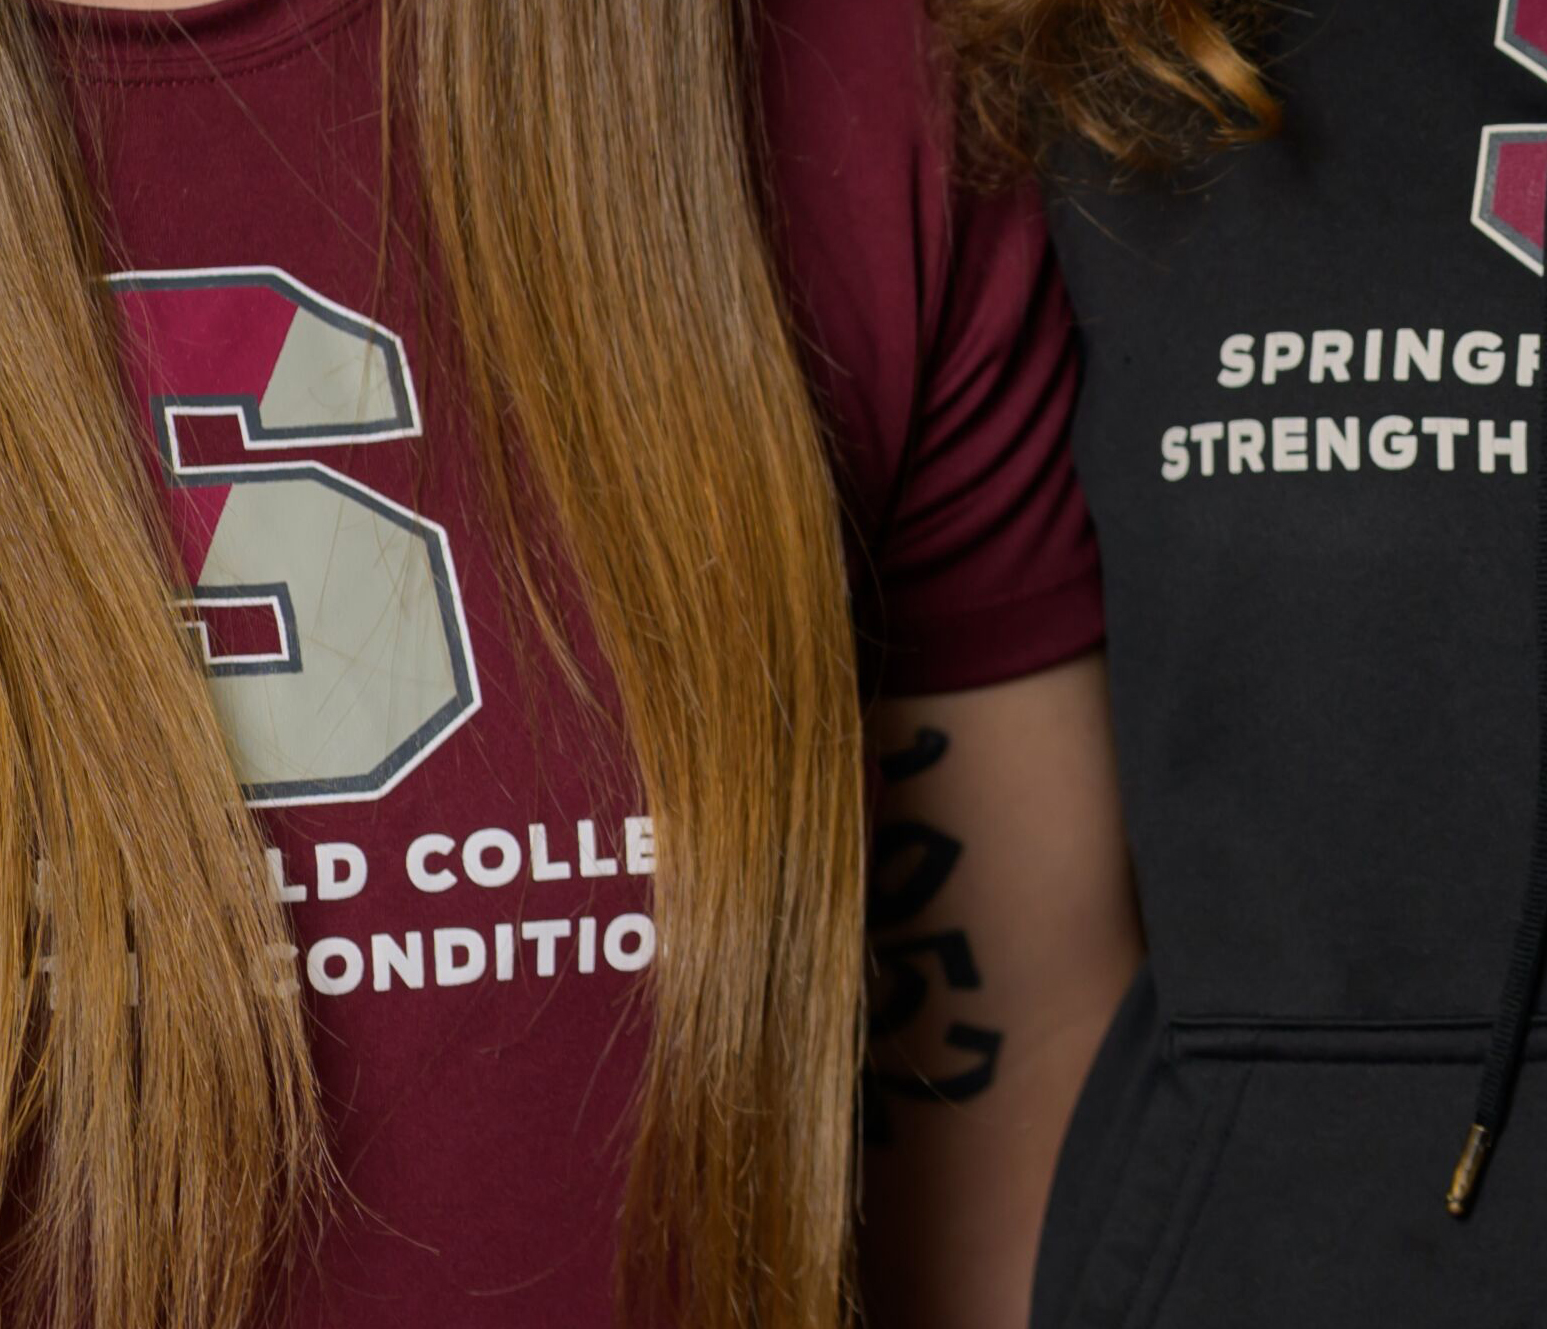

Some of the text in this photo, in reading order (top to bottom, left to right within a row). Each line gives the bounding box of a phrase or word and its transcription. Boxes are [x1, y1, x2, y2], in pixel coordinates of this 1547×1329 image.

[1161, 415, 1528, 482] STRENGTH
[406, 815, 658, 893] COLLE
[266, 912, 657, 999] ONDITIO
